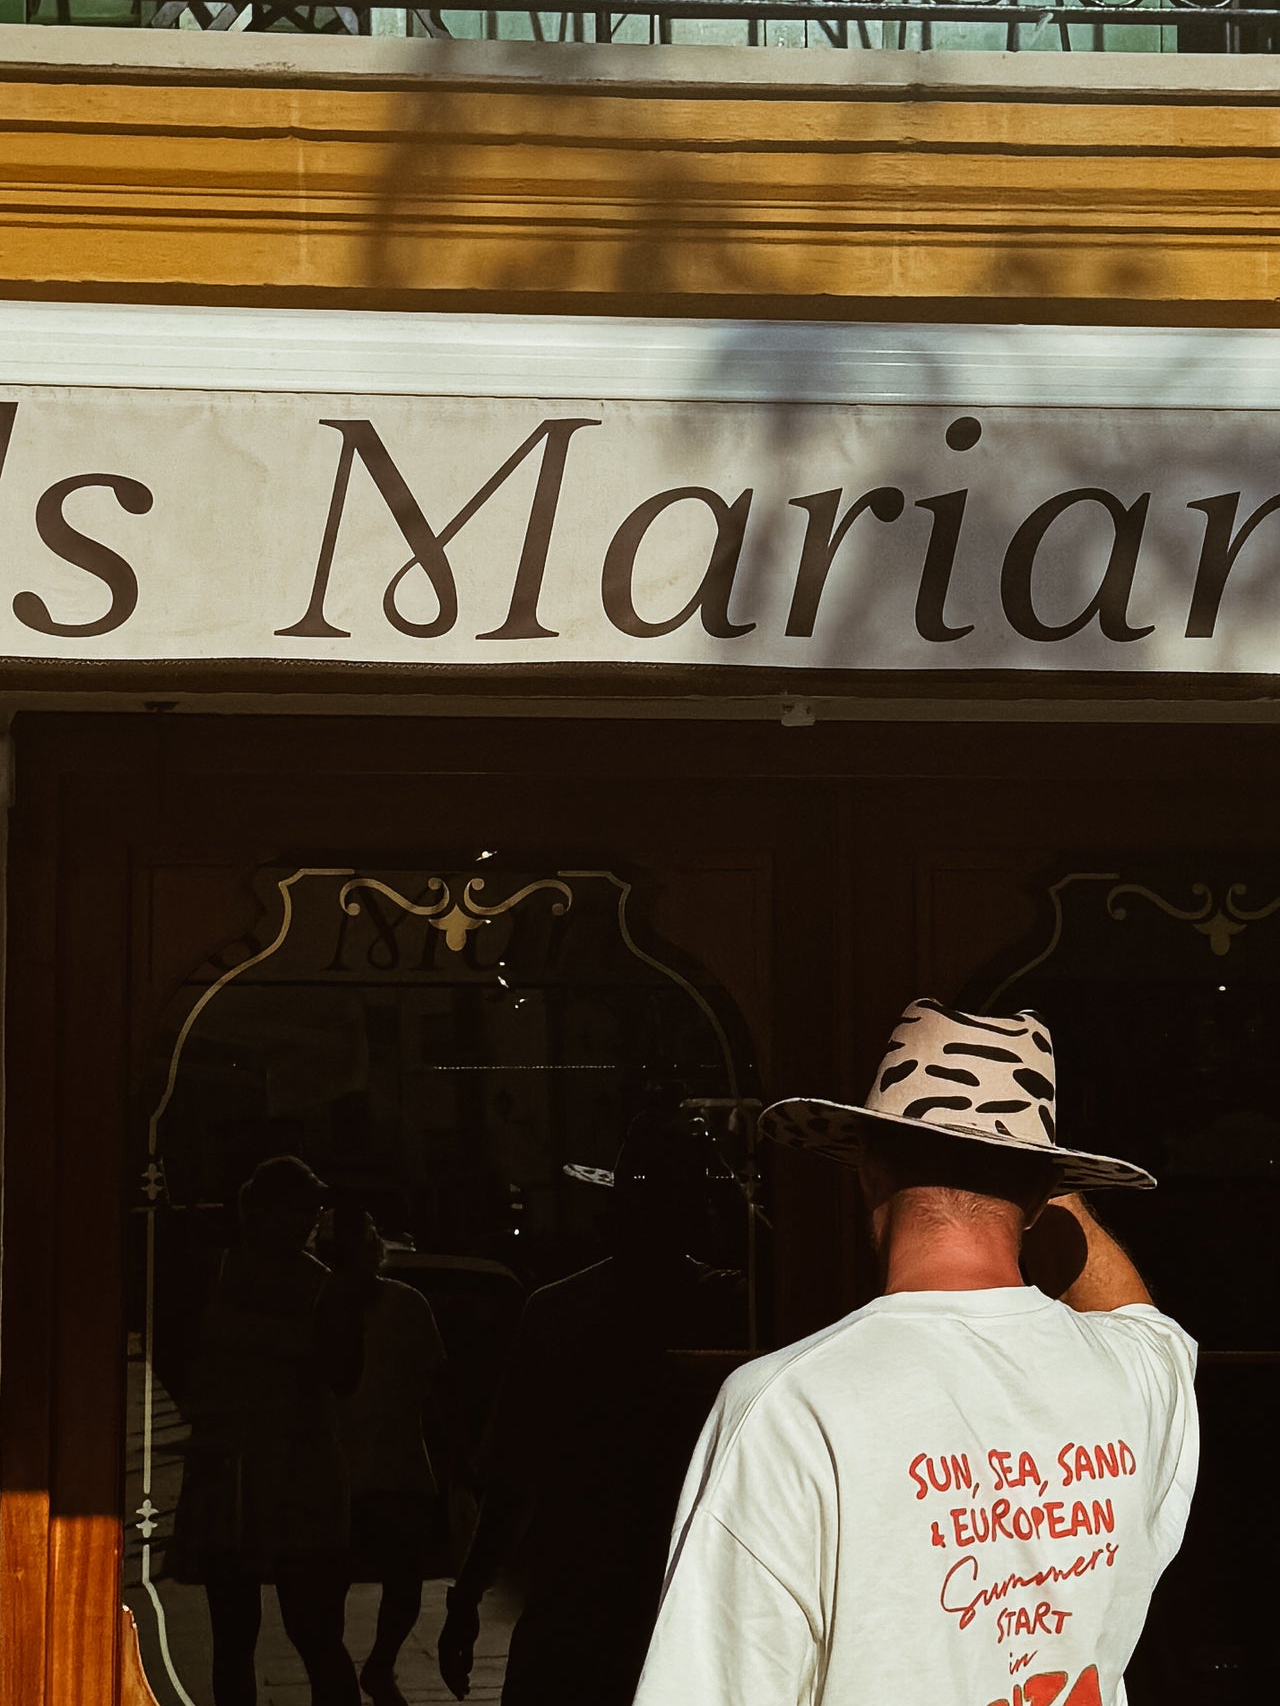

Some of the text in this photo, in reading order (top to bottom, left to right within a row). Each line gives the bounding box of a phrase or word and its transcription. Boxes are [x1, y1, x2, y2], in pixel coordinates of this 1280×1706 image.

[909, 1440, 1136, 1499] SUN, SEA, SAND
[931, 1499, 1116, 1548] & EUROPEAN
[940, 1544, 1119, 1630] Summers
[996, 1602, 1073, 1645] START
[1008, 1650, 1038, 1675] in
